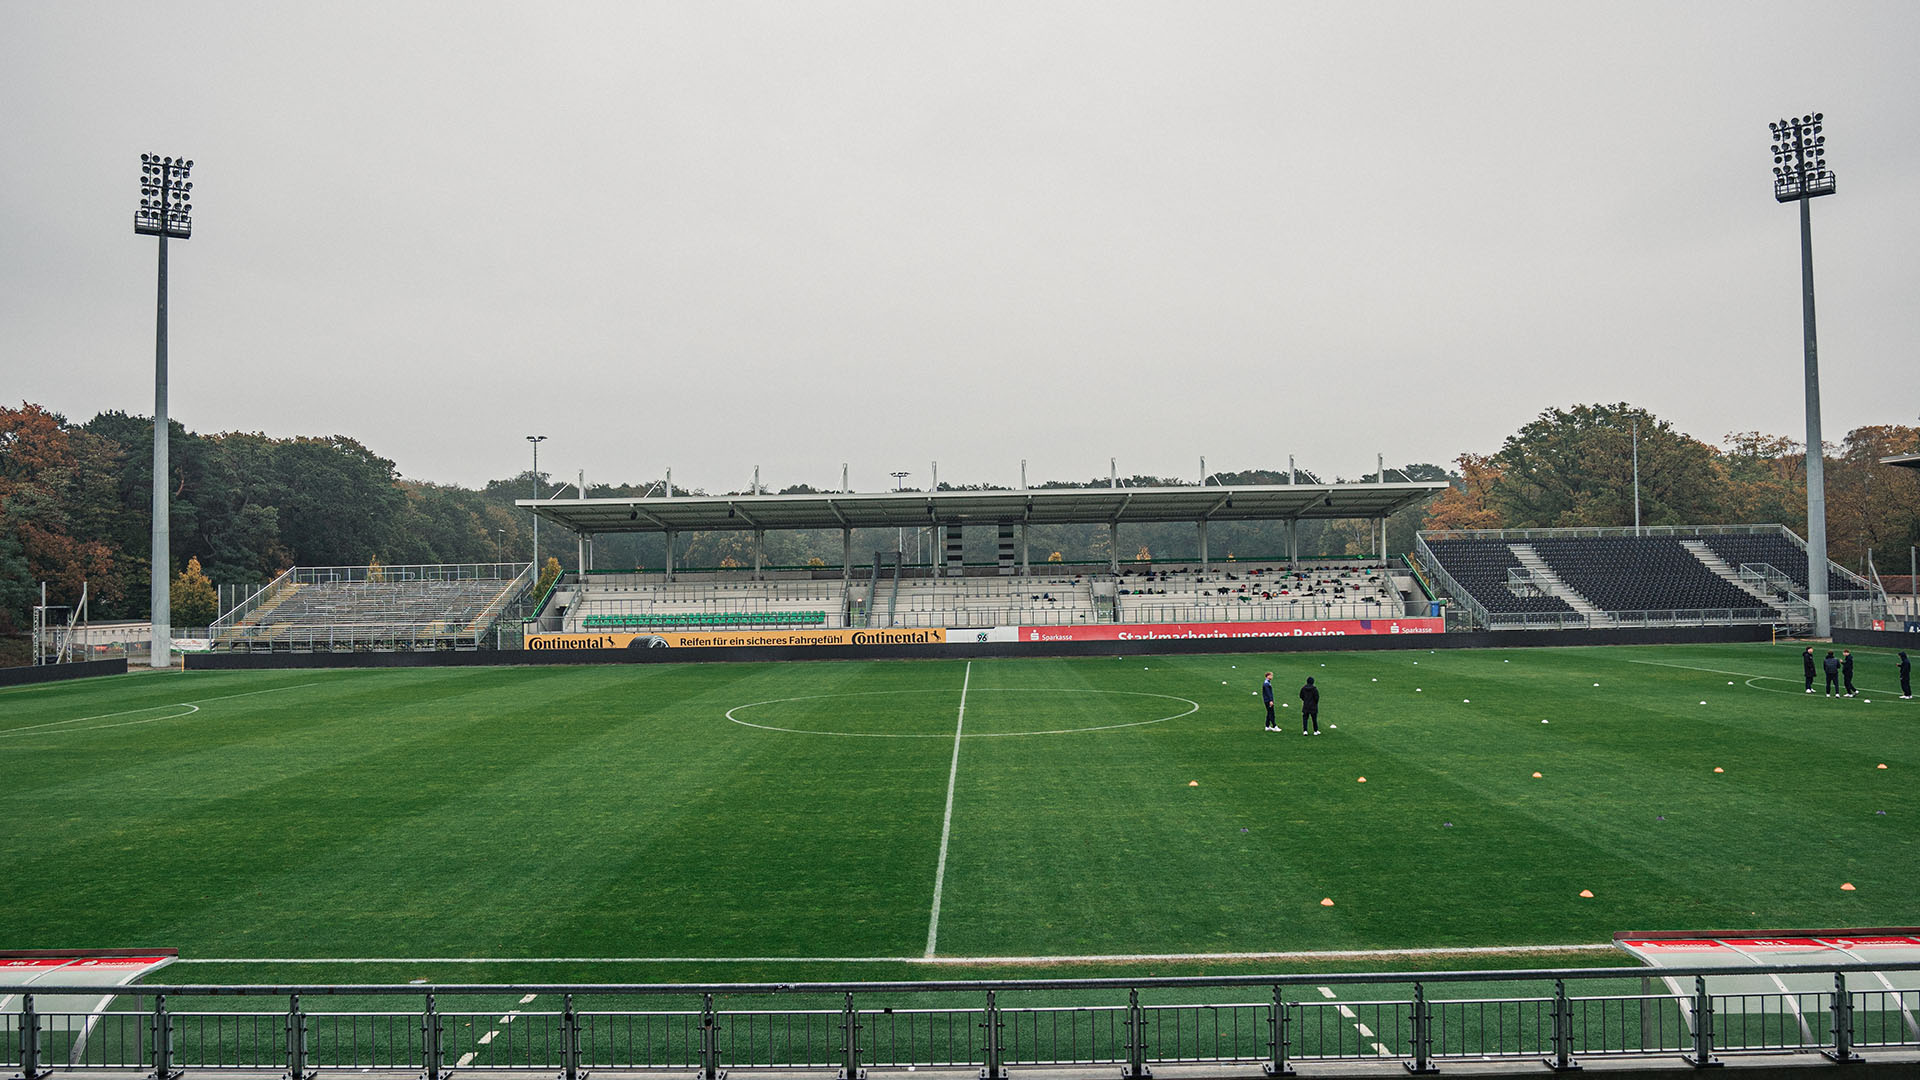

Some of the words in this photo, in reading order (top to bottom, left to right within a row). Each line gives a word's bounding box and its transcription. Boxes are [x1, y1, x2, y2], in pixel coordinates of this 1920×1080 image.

[528, 637, 603, 650] Continental
[680, 637, 711, 646] Reifen
[712, 637, 727, 646] für
[729, 637, 744, 645] ein
[746, 636, 787, 645] sicheres
[789, 635, 843, 645] Fahrgefühl
[851, 631, 928, 645] Continental
[1041, 634, 1072, 642] Sparkasse
